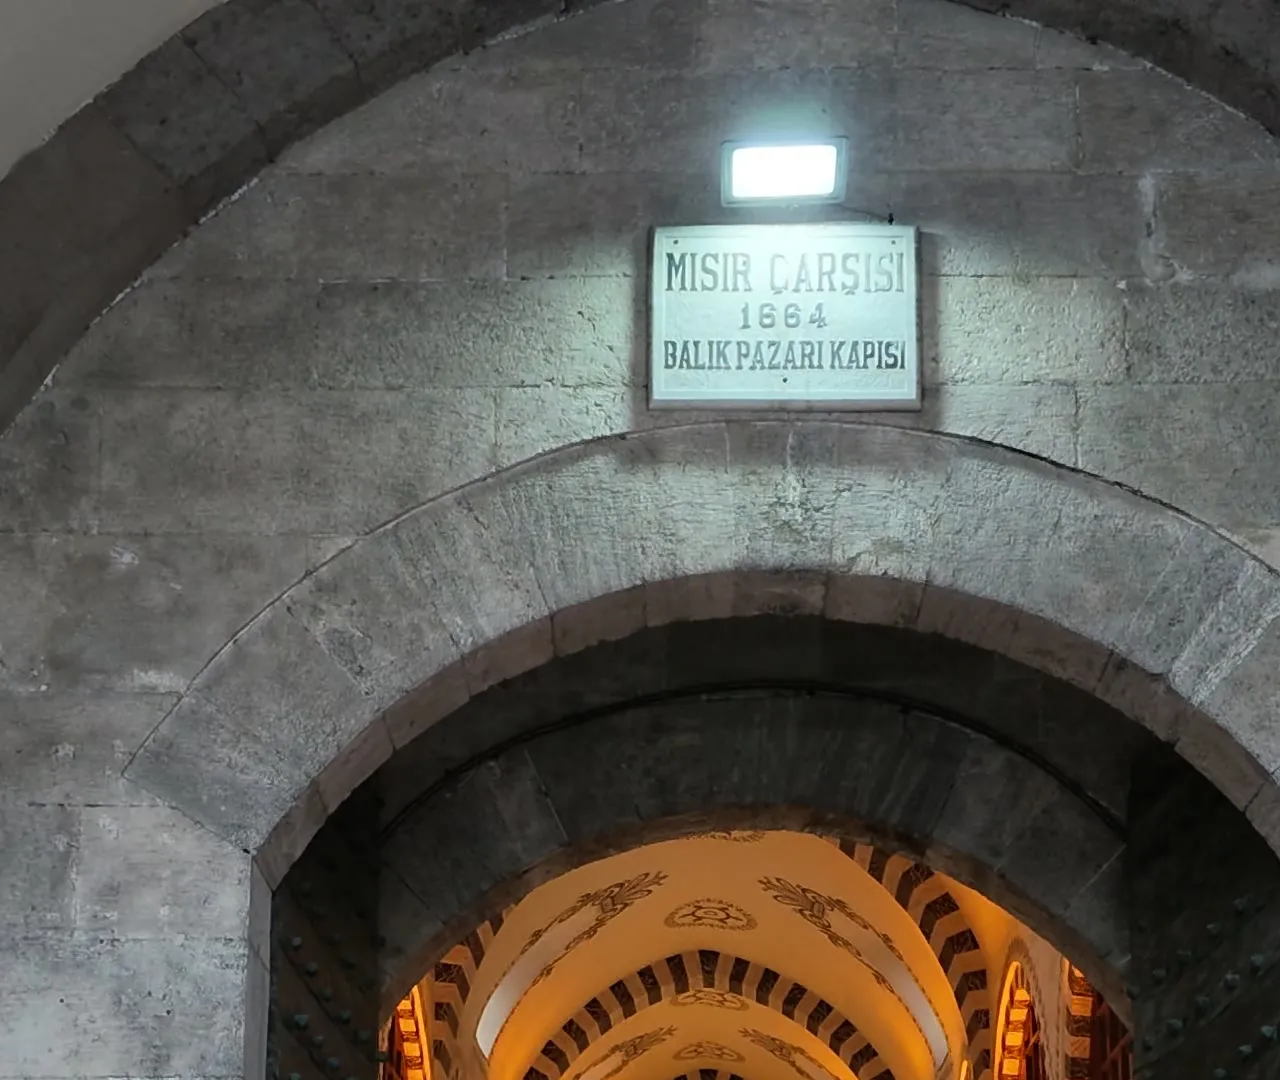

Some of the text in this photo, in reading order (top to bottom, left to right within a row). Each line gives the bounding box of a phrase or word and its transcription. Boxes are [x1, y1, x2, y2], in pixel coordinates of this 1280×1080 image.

[665, 252, 905, 295] MISIR ÇARŞISI
[739, 303, 828, 329] 1664
[664, 340, 906, 370] BALIK PAZARI KAPISI
